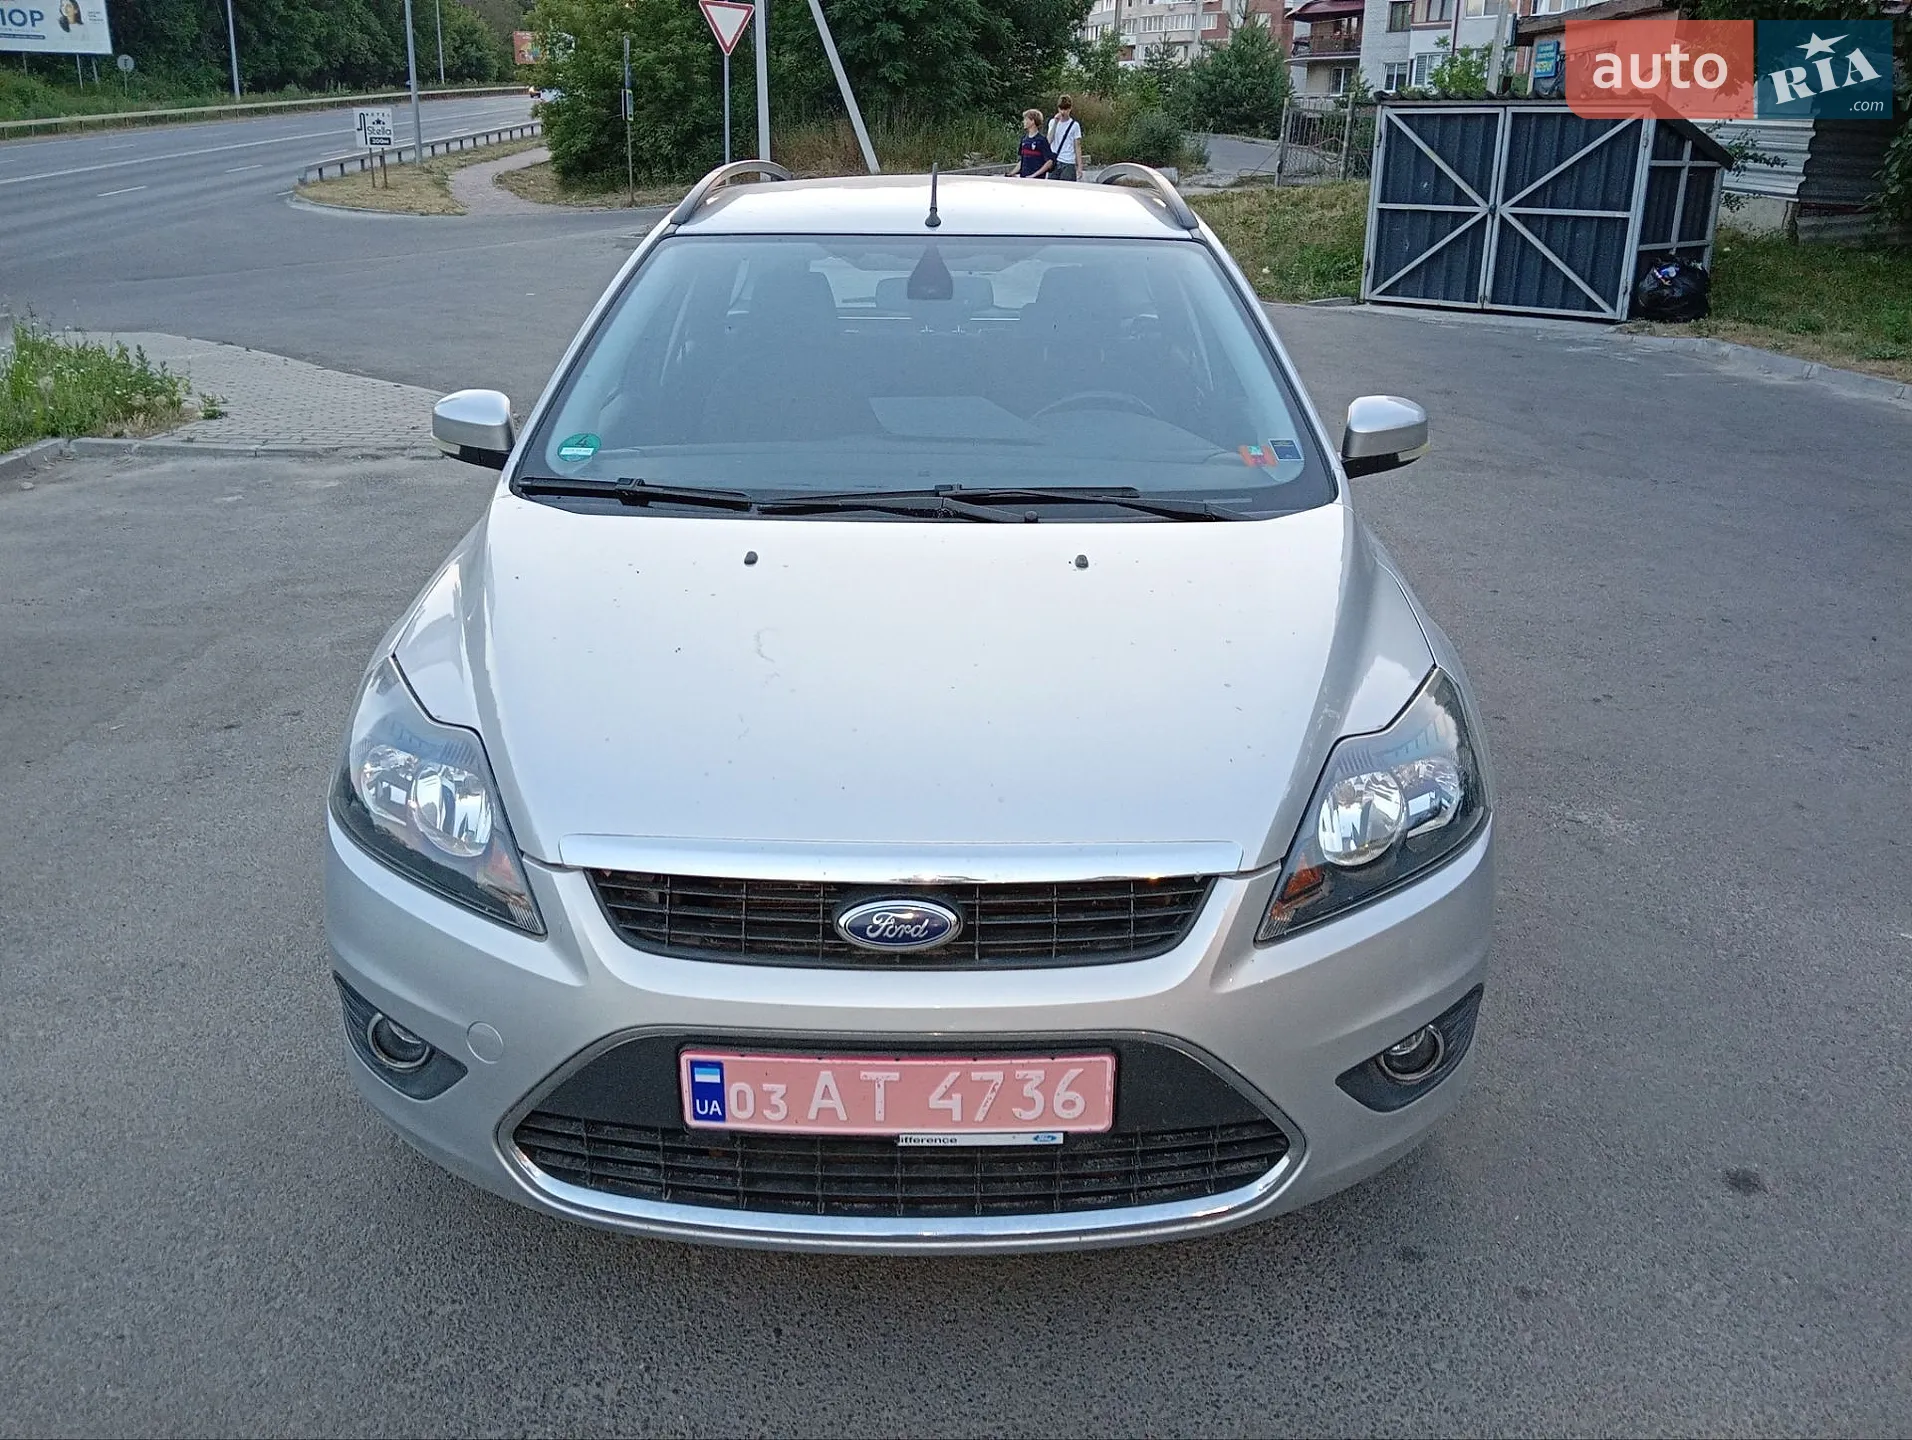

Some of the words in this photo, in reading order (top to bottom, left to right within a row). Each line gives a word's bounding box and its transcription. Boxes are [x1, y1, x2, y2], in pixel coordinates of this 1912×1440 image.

[367, 125, 392, 135] Stella
[866, 912, 929, 938] Ford
[729, 1081, 789, 1122] 03
[807, 1070, 901, 1122] AT
[928, 1067, 1088, 1122] 4736
[696, 1099, 723, 1117] UA
